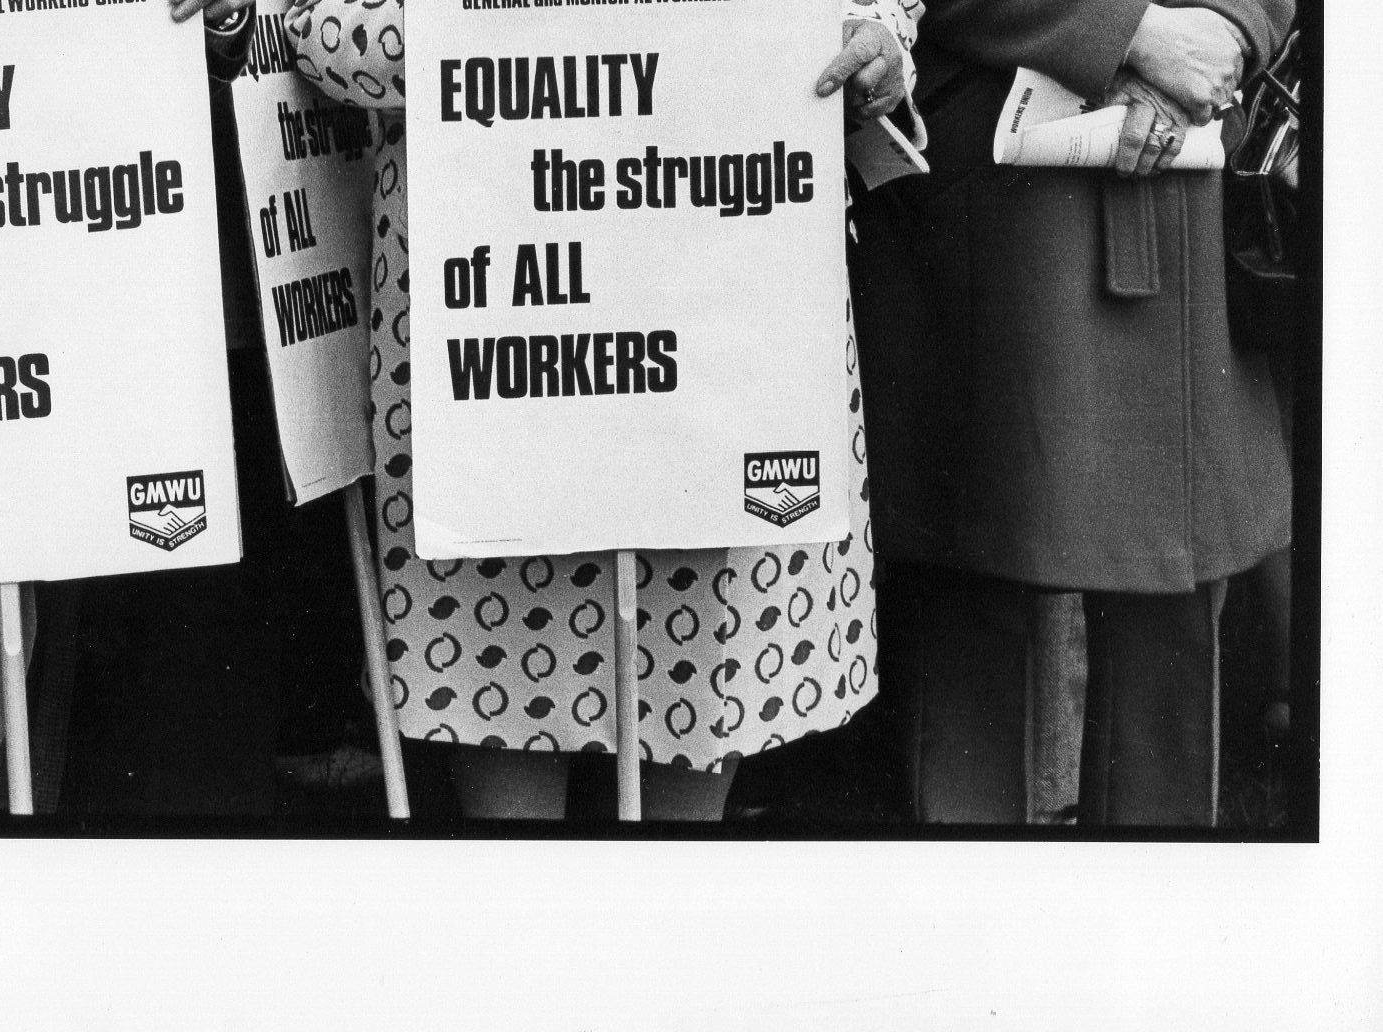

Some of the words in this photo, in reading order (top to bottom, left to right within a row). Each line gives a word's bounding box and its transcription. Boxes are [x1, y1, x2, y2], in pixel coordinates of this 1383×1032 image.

[441, 53, 659, 127] EQUALITY
[531, 149, 605, 211] the
[617, 141, 813, 217] struggle
[260, 195, 281, 258] of
[283, 188, 317, 253] ALL
[271, 267, 358, 347] WORKERS
[444, 246, 490, 309] of
[512, 242, 590, 306] ALL
[447, 330, 677, 400] WORKERS
[130, 477, 201, 506] GMWU
[748, 458, 815, 481] GMWU
[131, 528, 155, 541] UNITY
[156, 537, 165, 546] IS
[168, 521, 205, 548] STRENGTH
[746, 503, 768, 517] UNITY
[770, 512, 779, 522] IS
[781, 500, 818, 524] STRENGTH
